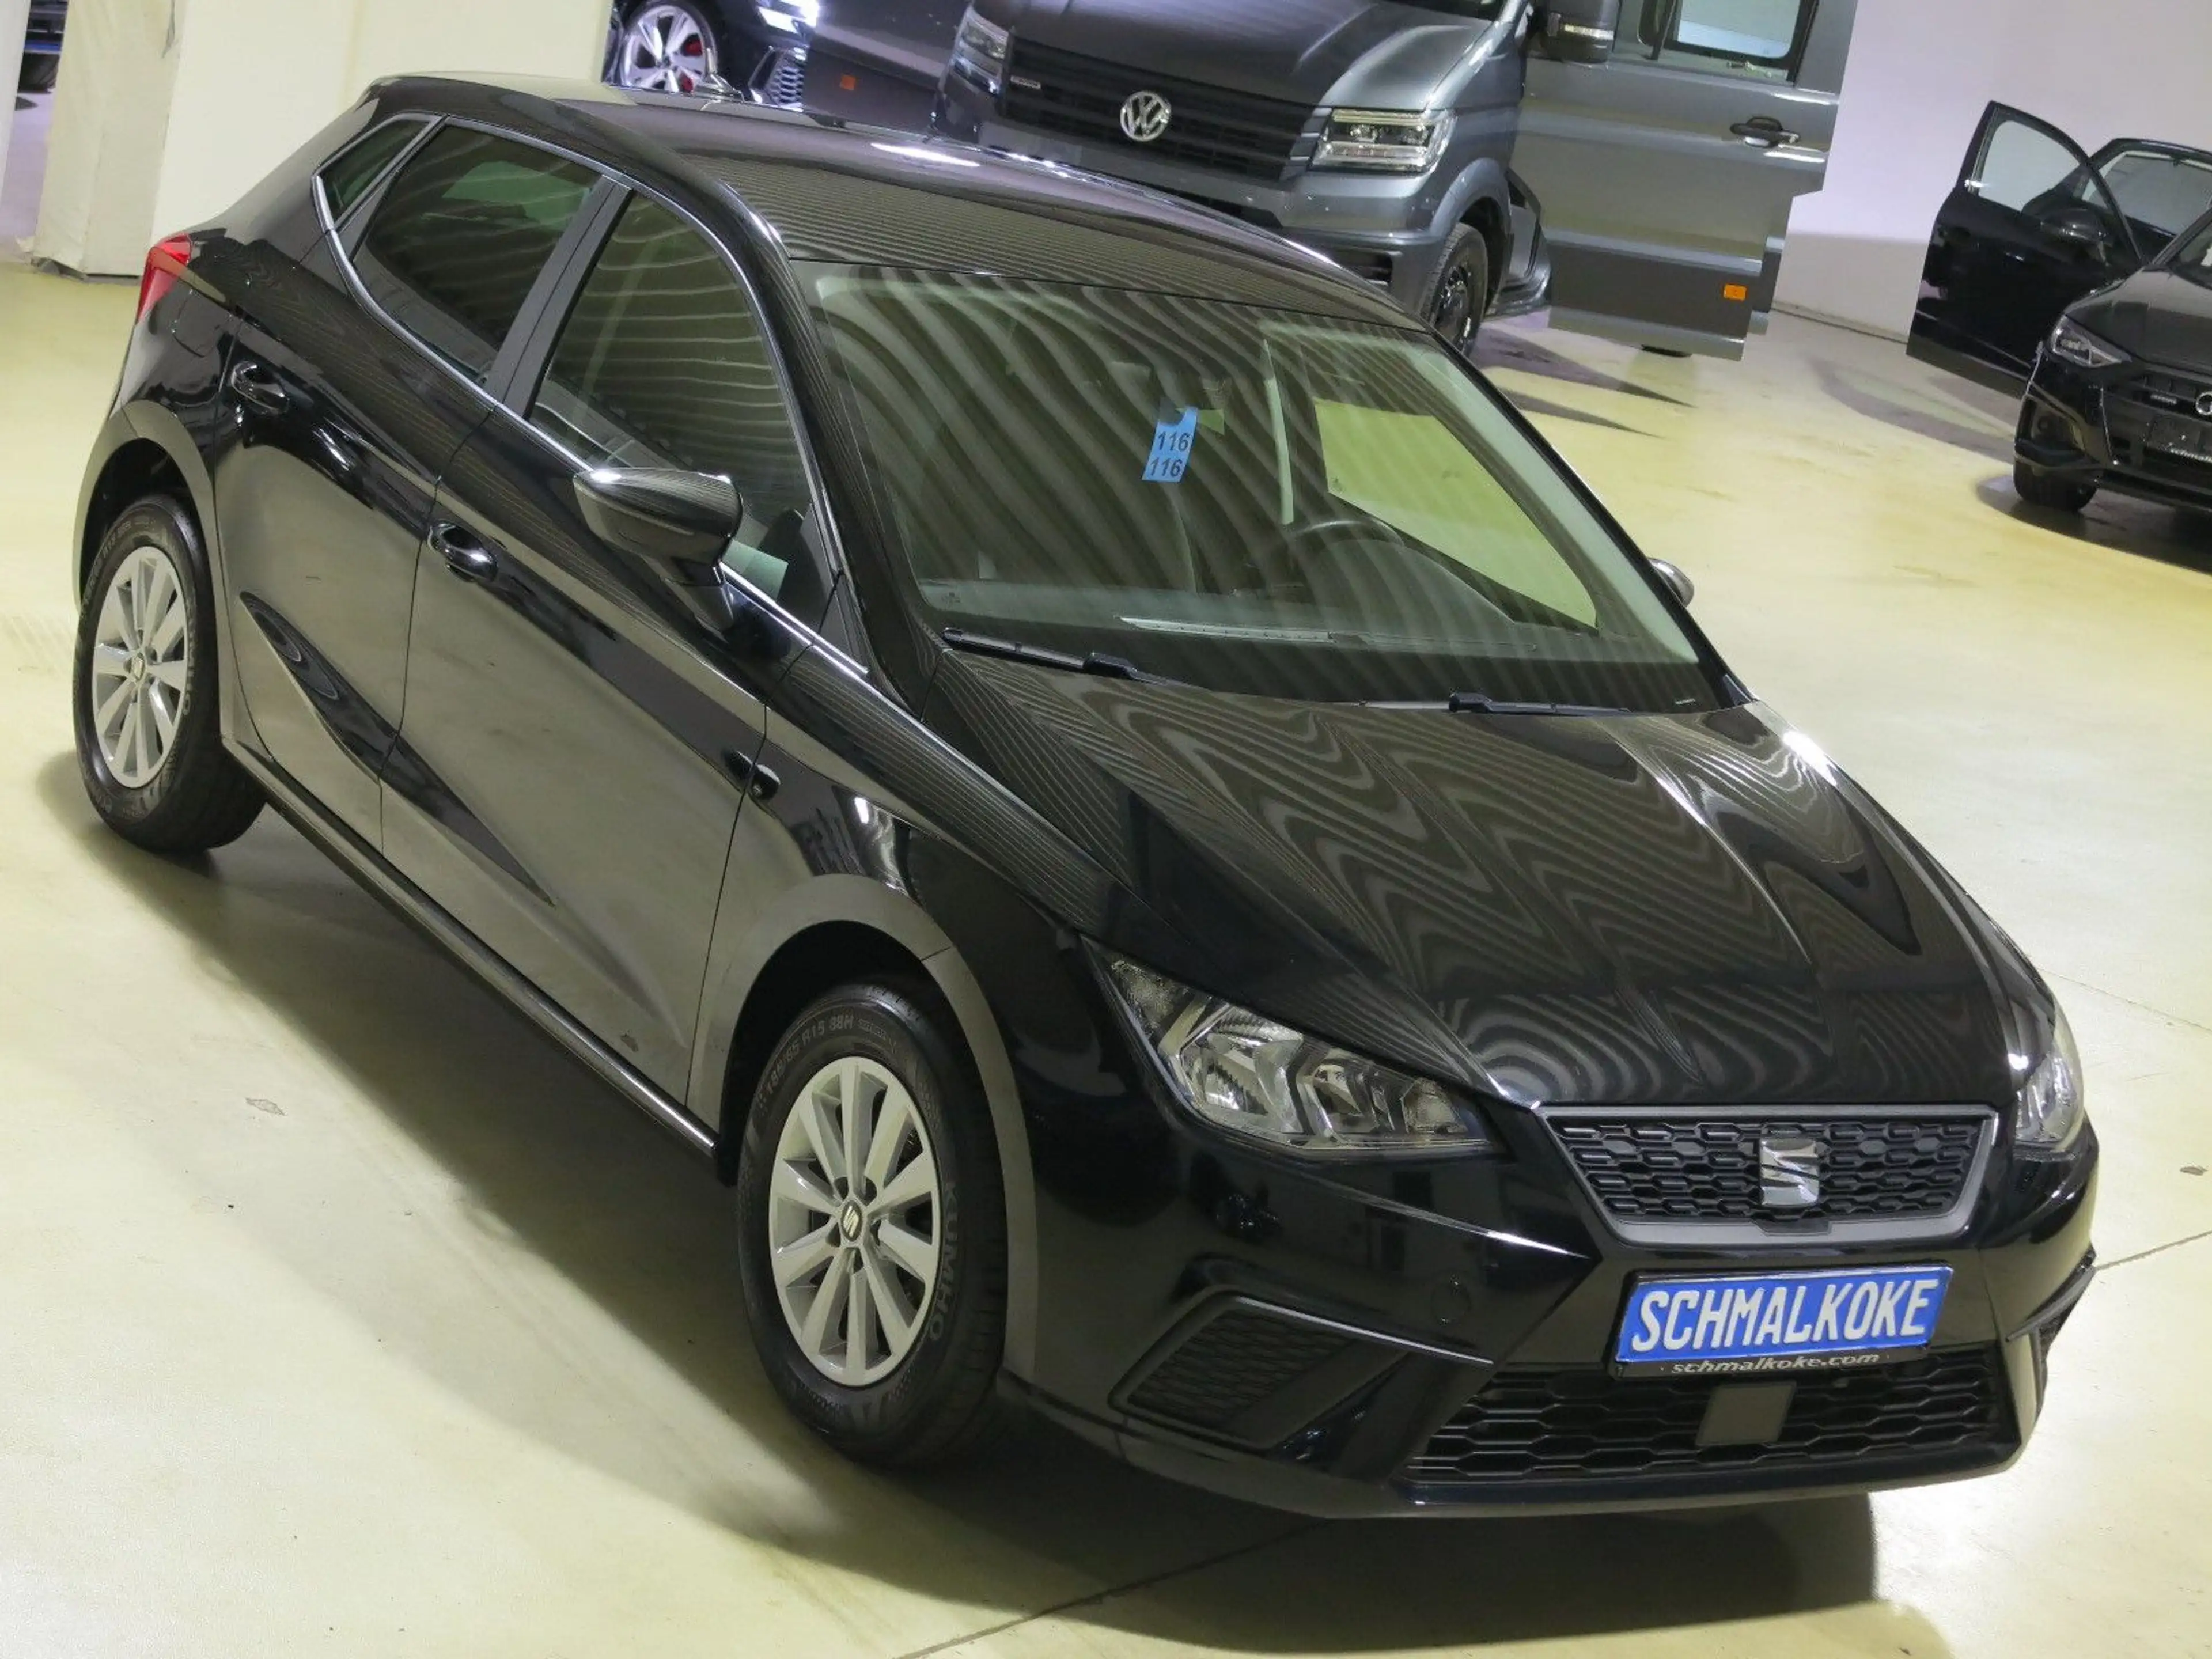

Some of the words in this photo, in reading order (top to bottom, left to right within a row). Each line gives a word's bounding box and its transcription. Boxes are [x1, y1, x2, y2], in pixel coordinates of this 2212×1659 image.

[1158, 431, 1191, 452] 116
[1150, 457, 1183, 477] 116
[929, 1182, 958, 1340] KUMHO
[1631, 1279, 1939, 1352] SCHMALKOKE
[1672, 1354, 1880, 1373] schmalkoke.com
